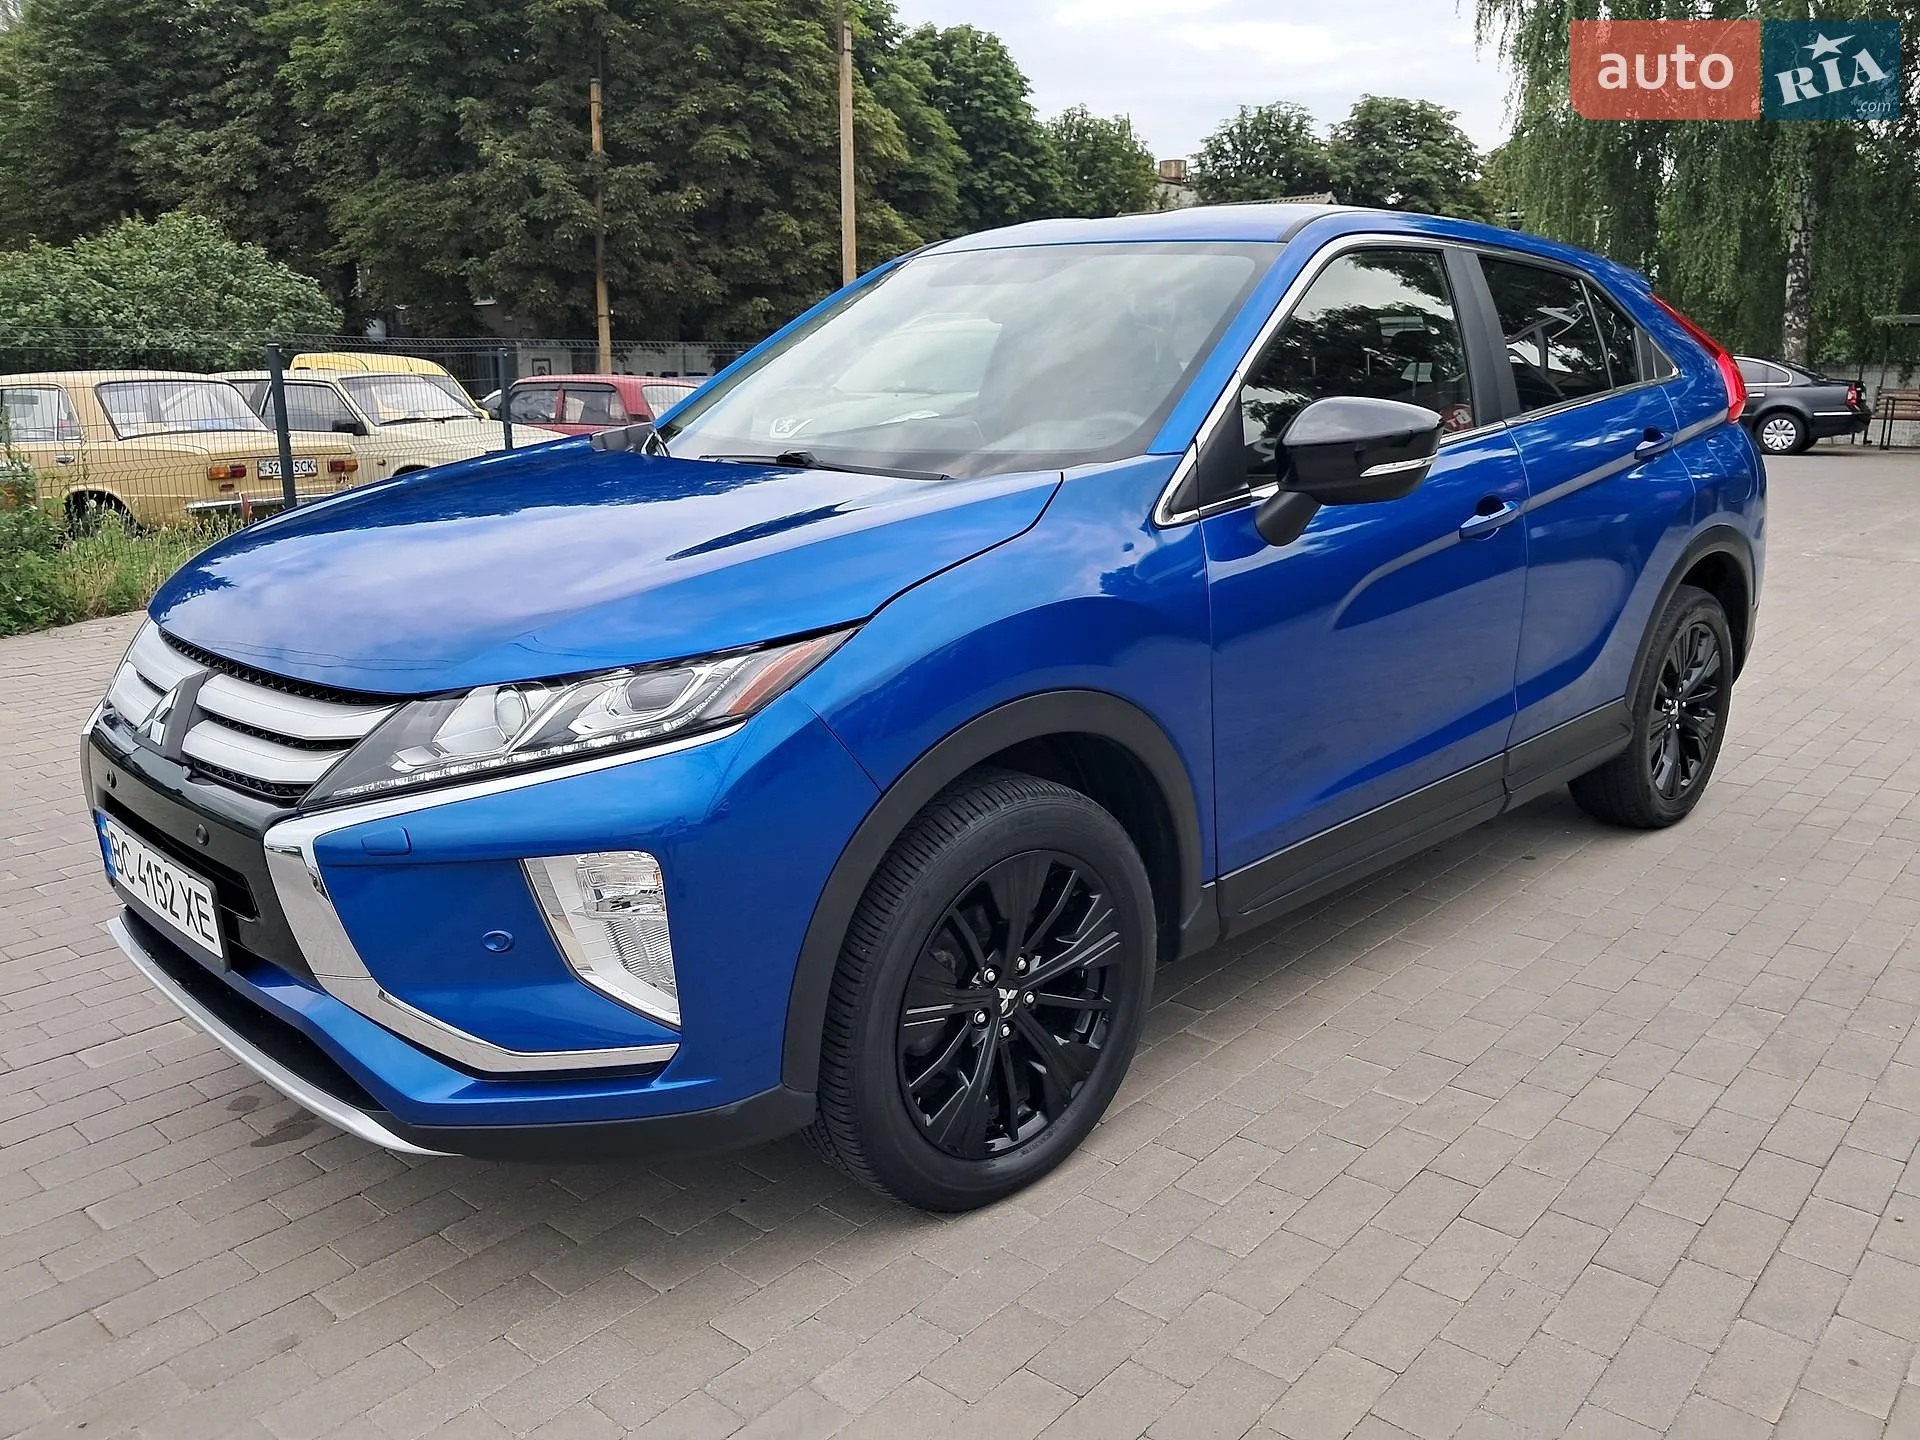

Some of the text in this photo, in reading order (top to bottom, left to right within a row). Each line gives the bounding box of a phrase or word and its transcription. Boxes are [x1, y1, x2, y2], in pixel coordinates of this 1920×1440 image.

[110, 831, 216, 944] BC 4152 XE
